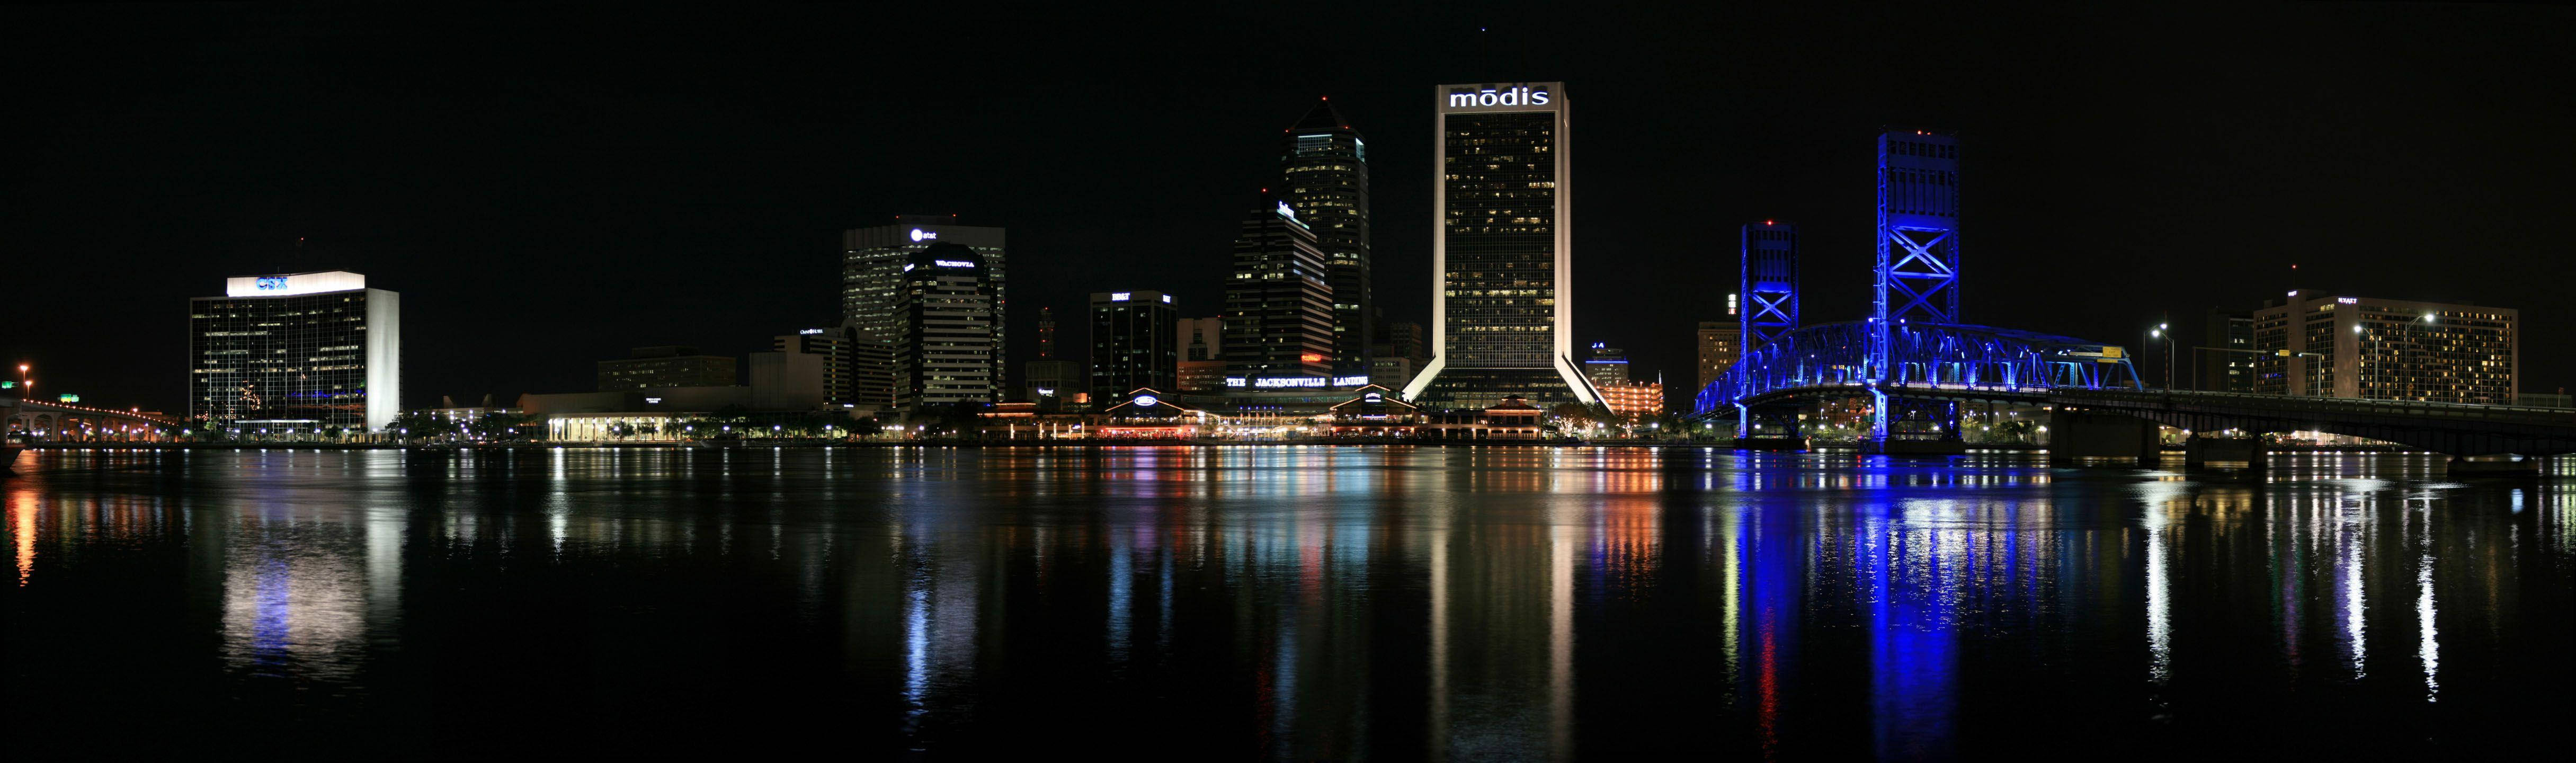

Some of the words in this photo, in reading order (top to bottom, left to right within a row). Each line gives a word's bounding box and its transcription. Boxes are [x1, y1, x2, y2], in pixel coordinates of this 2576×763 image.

[256, 277, 288, 290] CSX
[1112, 292, 1130, 301] BB&T
[1226, 378, 1246, 387] THE
[1255, 377, 1325, 387] JACKSONVILLE
[1333, 376, 1368, 386] LANDING
